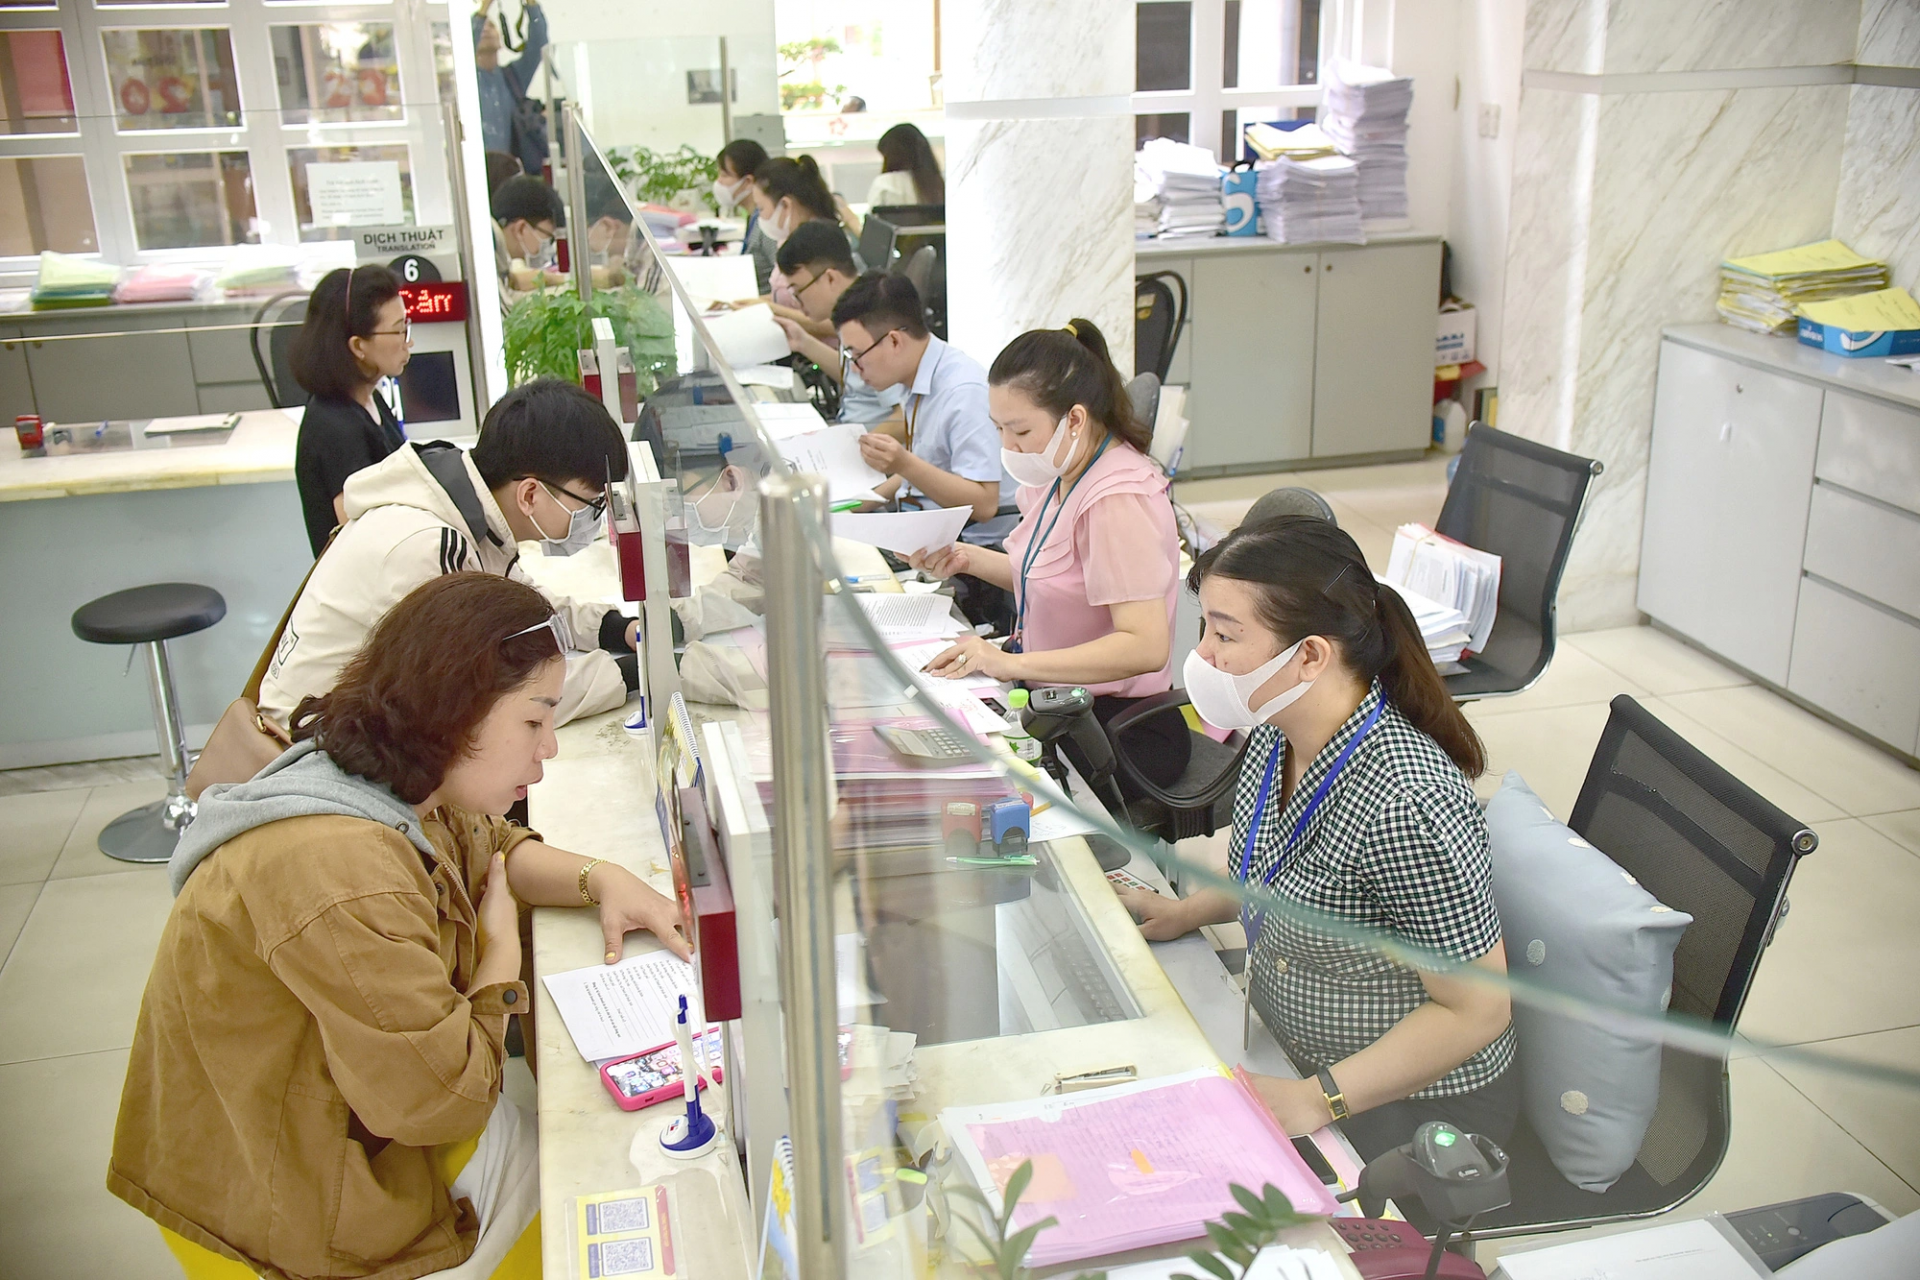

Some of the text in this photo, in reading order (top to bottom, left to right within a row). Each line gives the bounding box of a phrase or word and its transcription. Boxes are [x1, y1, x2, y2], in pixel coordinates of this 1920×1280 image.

[363, 229, 444, 247] DỊCH THUẬT
[377, 243, 436, 253] TRANSLATION
[404, 258, 419, 283] 6
